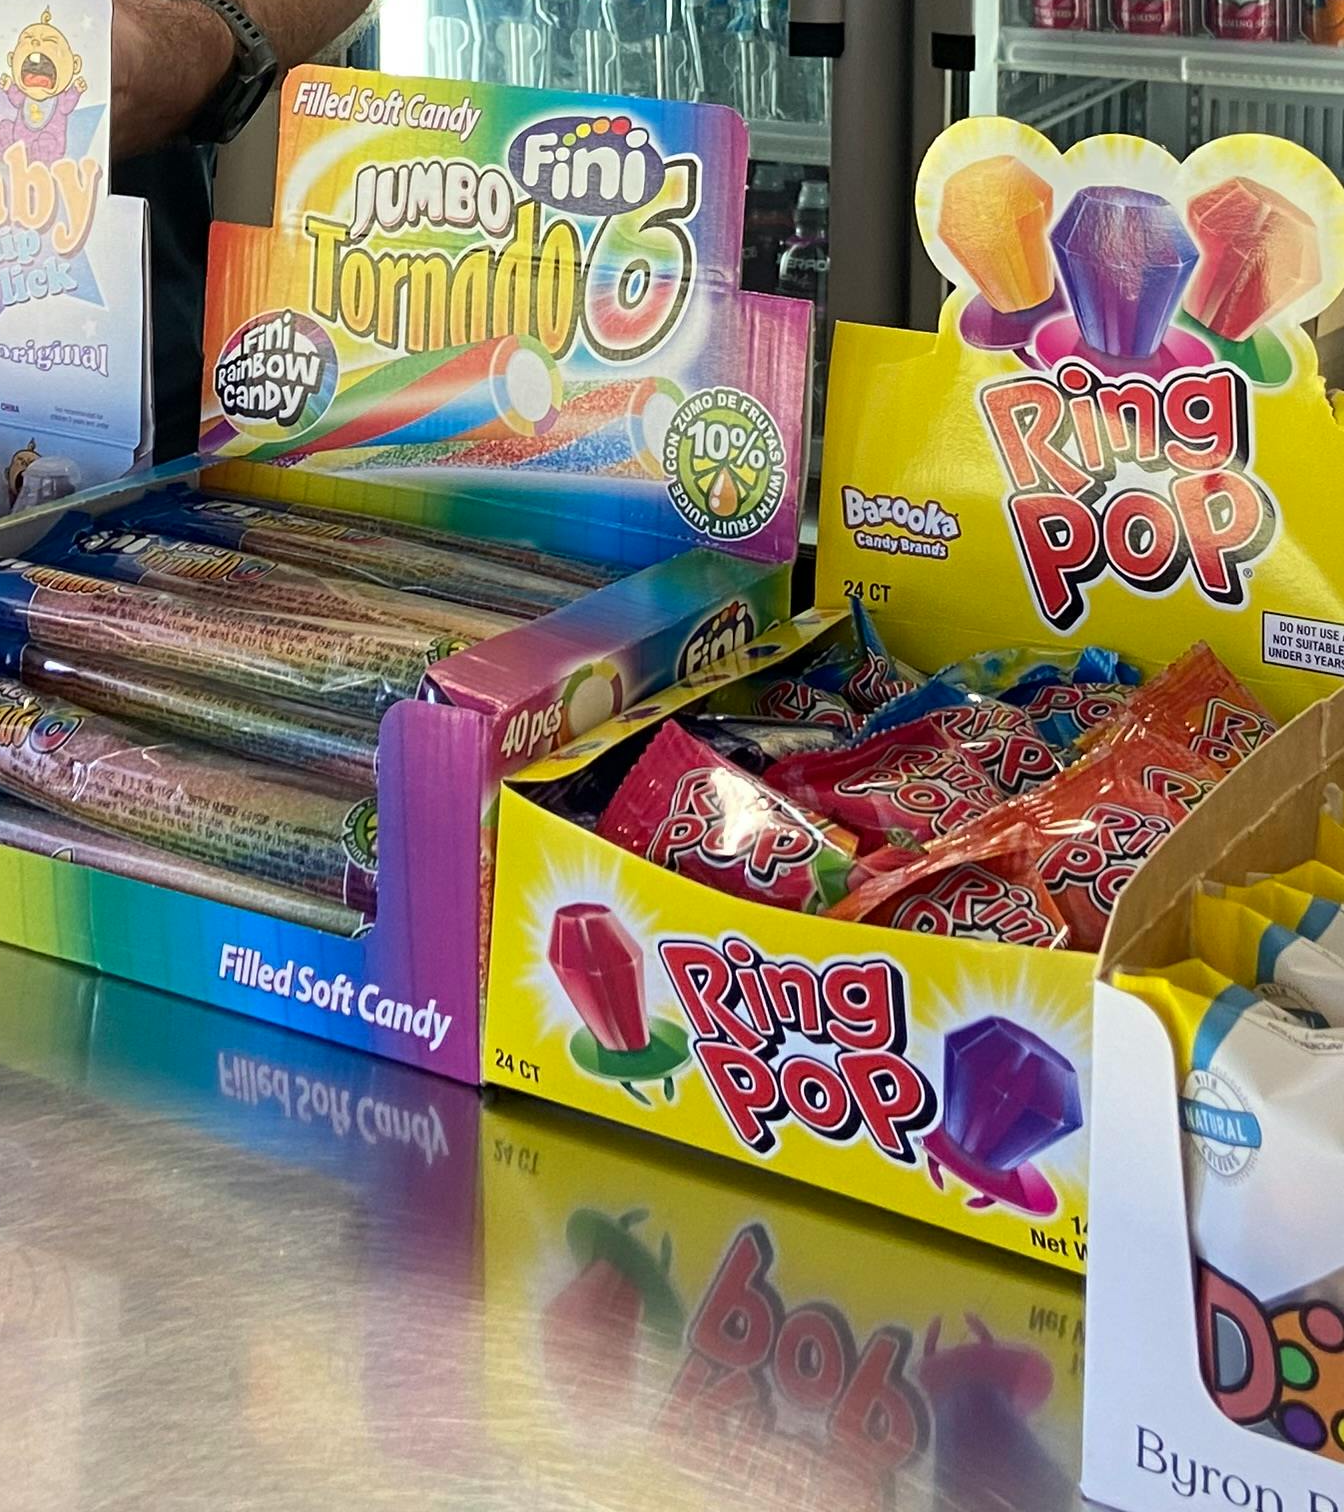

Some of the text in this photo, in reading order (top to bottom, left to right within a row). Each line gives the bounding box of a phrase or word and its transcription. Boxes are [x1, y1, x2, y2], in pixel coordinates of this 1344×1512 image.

[292, 81, 483, 142] Filled Soft Candy
[523, 116, 649, 205] Fini
[350, 160, 516, 239] JUMBO
[305, 201, 582, 360] Tornado
[241, 312, 295, 354] Fini
[666, 392, 782, 472] CON ZUMO DE FRUTAS
[687, 420, 766, 470] 10%
[984, 364, 1244, 498] Ring
[671, 474, 783, 537] WITH FRUIT JUICE
[843, 487, 959, 541] Bazooka
[856, 531, 949, 560] Candy Brands
[1010, 471, 1269, 631] POP
[843, 579, 891, 604] 24 CT
[684, 602, 754, 677] Fini
[1268, 647, 1302, 662] UNDER
[1305, 653, 1312, 664] 3
[1273, 634, 1293, 647] NOT
[1296, 637, 1344, 656] SUITABLE
[1279, 621, 1294, 633] DO
[1296, 624, 1316, 638] NOT
[1319, 627, 1339, 641] USE
[501, 698, 564, 759] 40 pcs
[651, 810, 818, 887] POP
[217, 942, 453, 1054] Filled Soft Candy
[658, 936, 906, 1050] Ring
[495, 1047, 541, 1085] 24 CT
[697, 1040, 936, 1160] POP
[1184, 1104, 1249, 1143] NATURAL
[1032, 1226, 1068, 1255] Net
[1135, 1425, 1284, 1512] Byron
